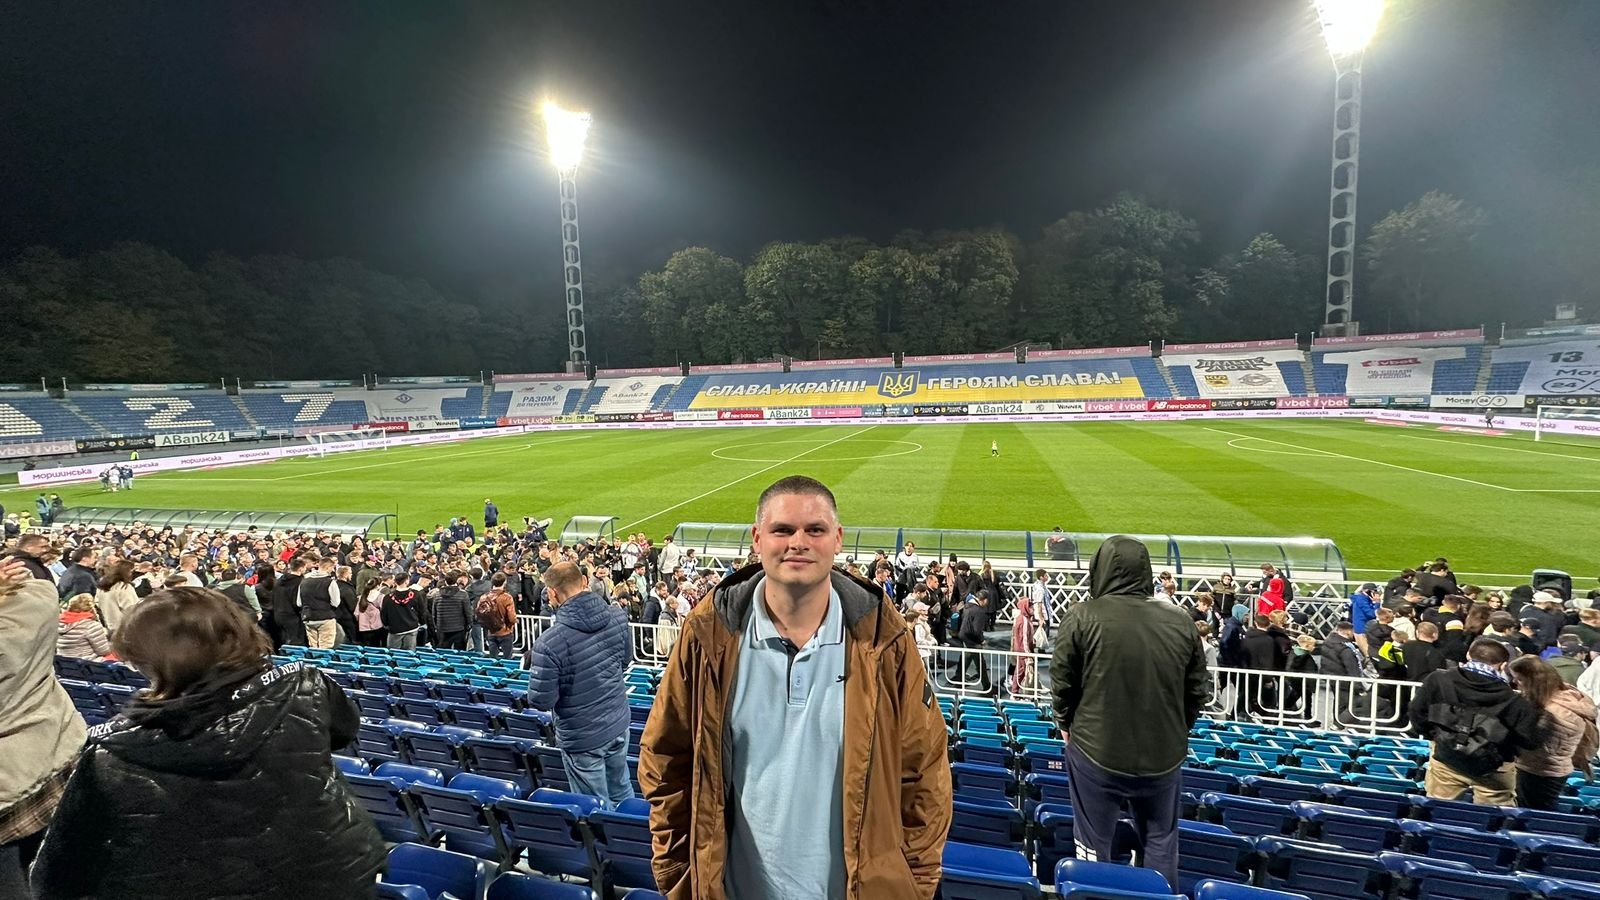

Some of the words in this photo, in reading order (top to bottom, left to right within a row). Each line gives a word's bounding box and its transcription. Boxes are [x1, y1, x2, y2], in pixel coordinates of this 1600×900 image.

[1548, 351, 1584, 363] 13
[926, 375, 1018, 391] ГЕРОЯМ
[1024, 371, 1121, 387] СЛАВА!
[705, 383, 771, 397] СЛАВА
[776, 379, 867, 395] УКРАЇНІ!
[523, 395, 556, 403] РАЗОМ
[1284, 399, 1312, 407] vbet
[1320, 399, 1349, 407] vbet
[1445, 397, 1475, 405] Money
[976, 404, 1022, 414] ABank24
[1096, 402, 1114, 410] vbet
[1125, 402, 1146, 410] vbet
[769, 409, 809, 418] ABank24
[163, 432, 226, 446] ABank24
[43, 443, 76, 453] vbet
[181, 456, 222, 464] моршинська
[33, 469, 92, 480] моршинська
[260, 670, 276, 686] 97
[279, 662, 300, 676] NEW
